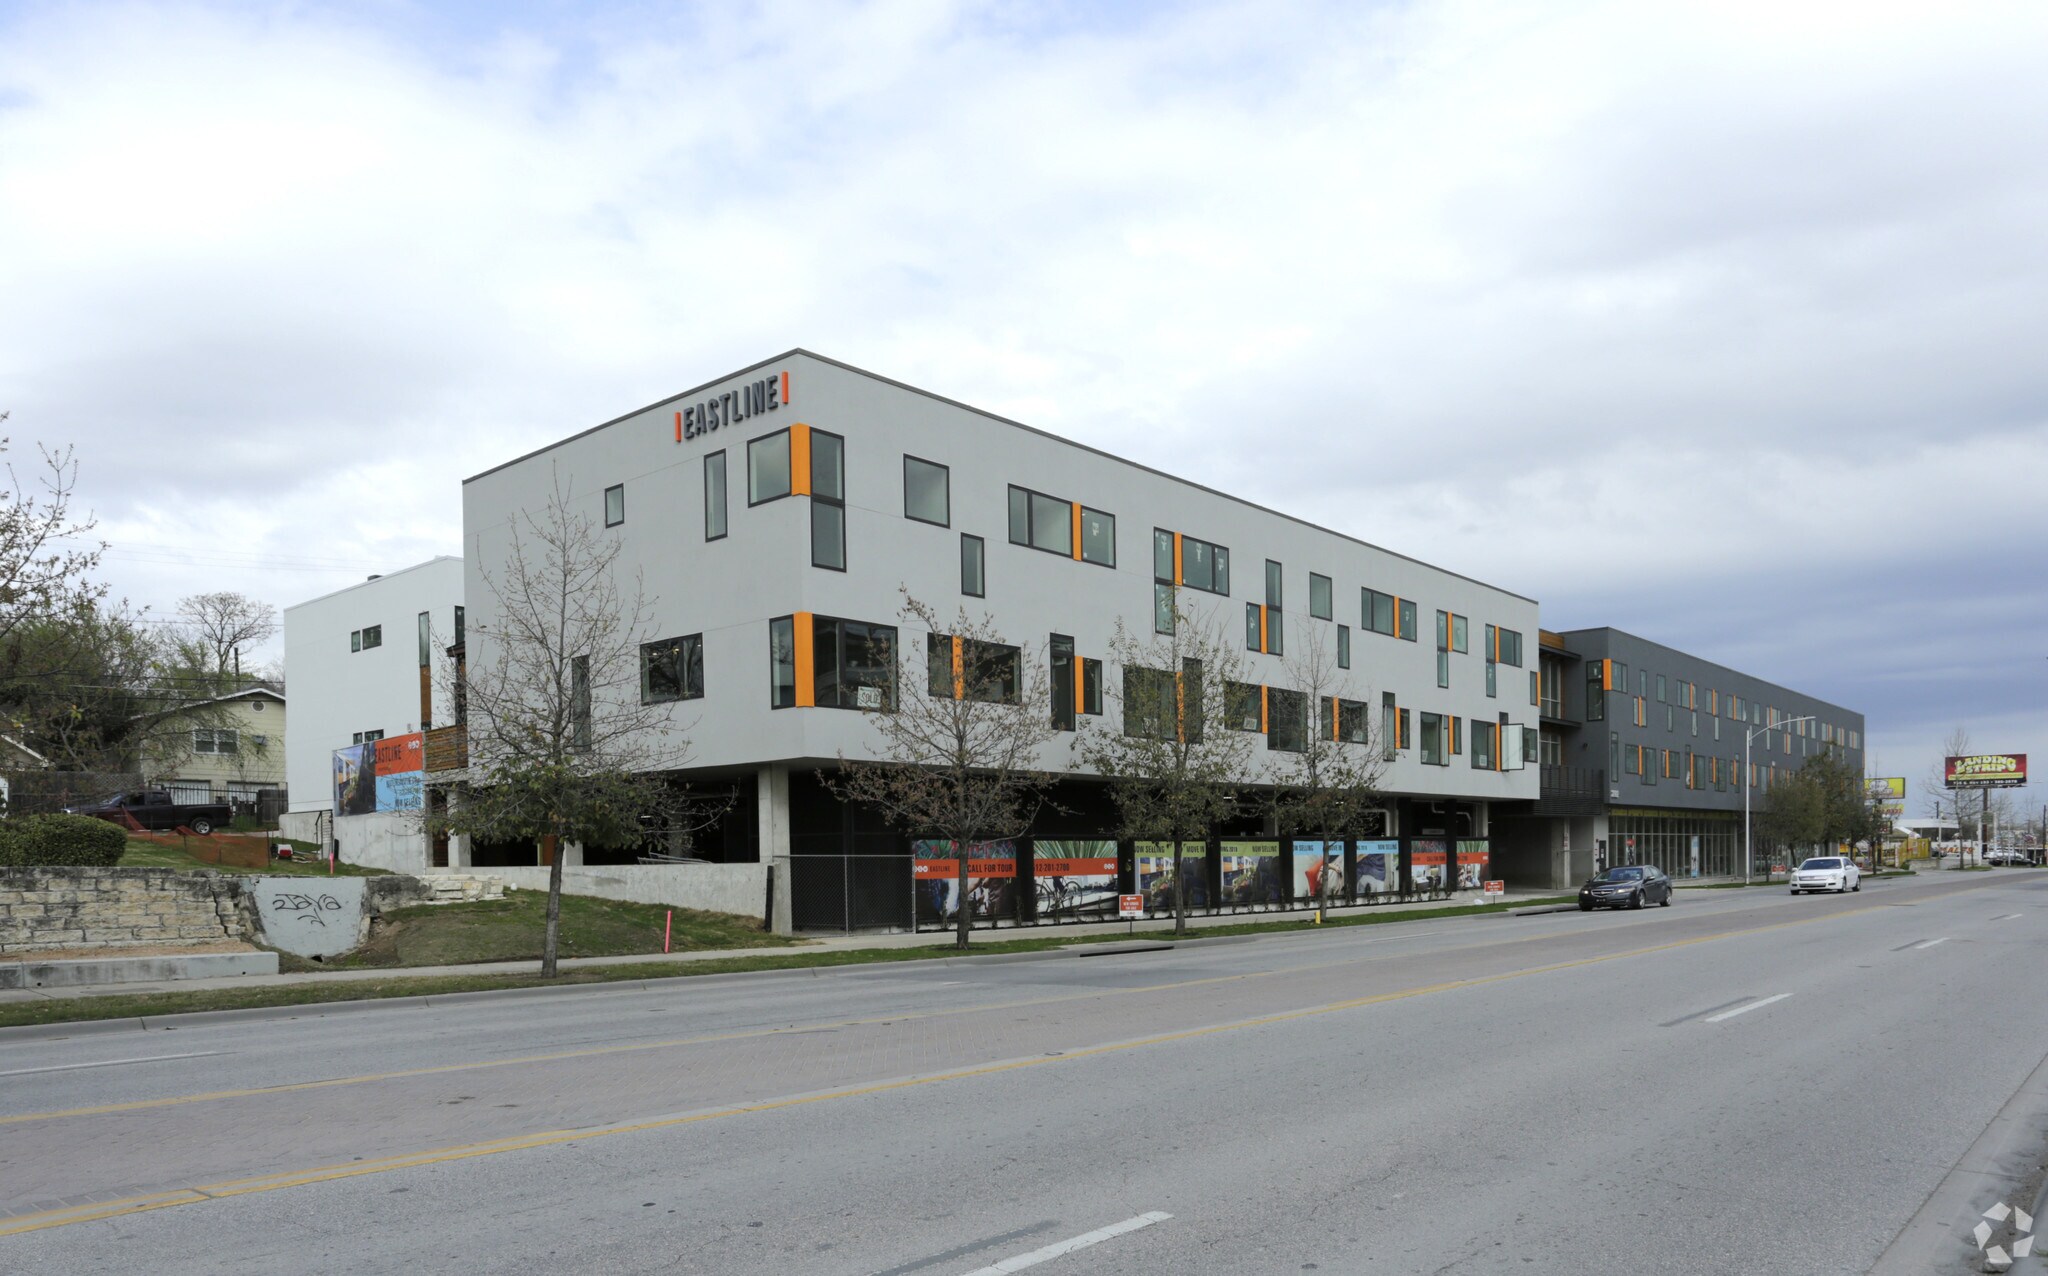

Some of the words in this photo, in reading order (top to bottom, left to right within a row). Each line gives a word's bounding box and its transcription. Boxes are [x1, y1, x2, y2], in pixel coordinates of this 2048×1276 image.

[683, 375, 779, 440] EASTLINE
[375, 744, 401, 764] EASTLINE
[1955, 755, 2016, 774] LANDING
[1966, 763, 2006, 773] STRIP
[1252, 845, 1261, 853] NOW
[1262, 845, 1277, 853] SELLING
[929, 865, 951, 873] EASTLINE
[967, 864, 983, 873] CALL
[984, 864, 996, 872] FOR
[997, 863, 1013, 872] TOUR
[1034, 863, 1070, 872] 12-201-2700
